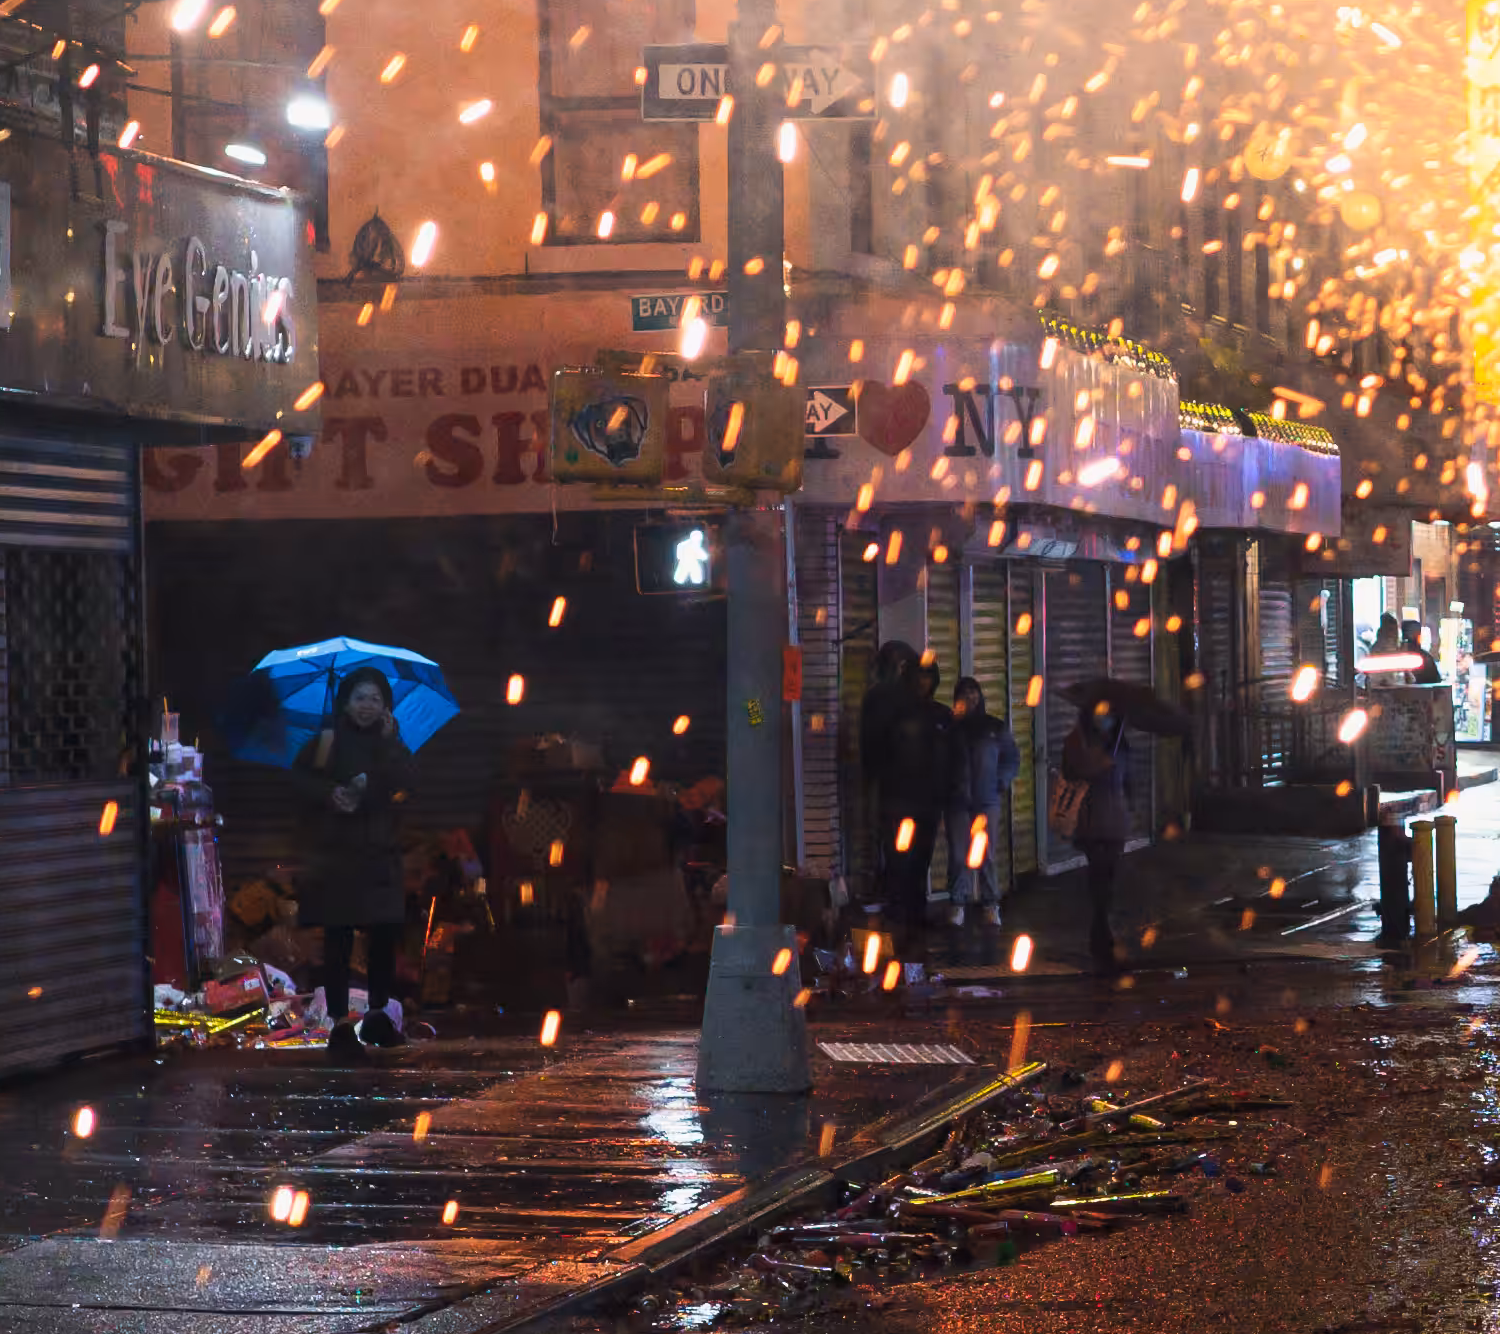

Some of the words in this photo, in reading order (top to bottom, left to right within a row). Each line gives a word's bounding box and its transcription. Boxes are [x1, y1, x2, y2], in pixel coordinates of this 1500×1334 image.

[677, 68, 731, 97] ON
[103, 219, 177, 370] Eye
[185, 236, 296, 365] Genius
[638, 293, 726, 318] BAYRD
[322, 367, 443, 400] AYER
[806, 402, 834, 421] AY
[942, 383, 1042, 459] NY
[426, 406, 706, 489] SHP
